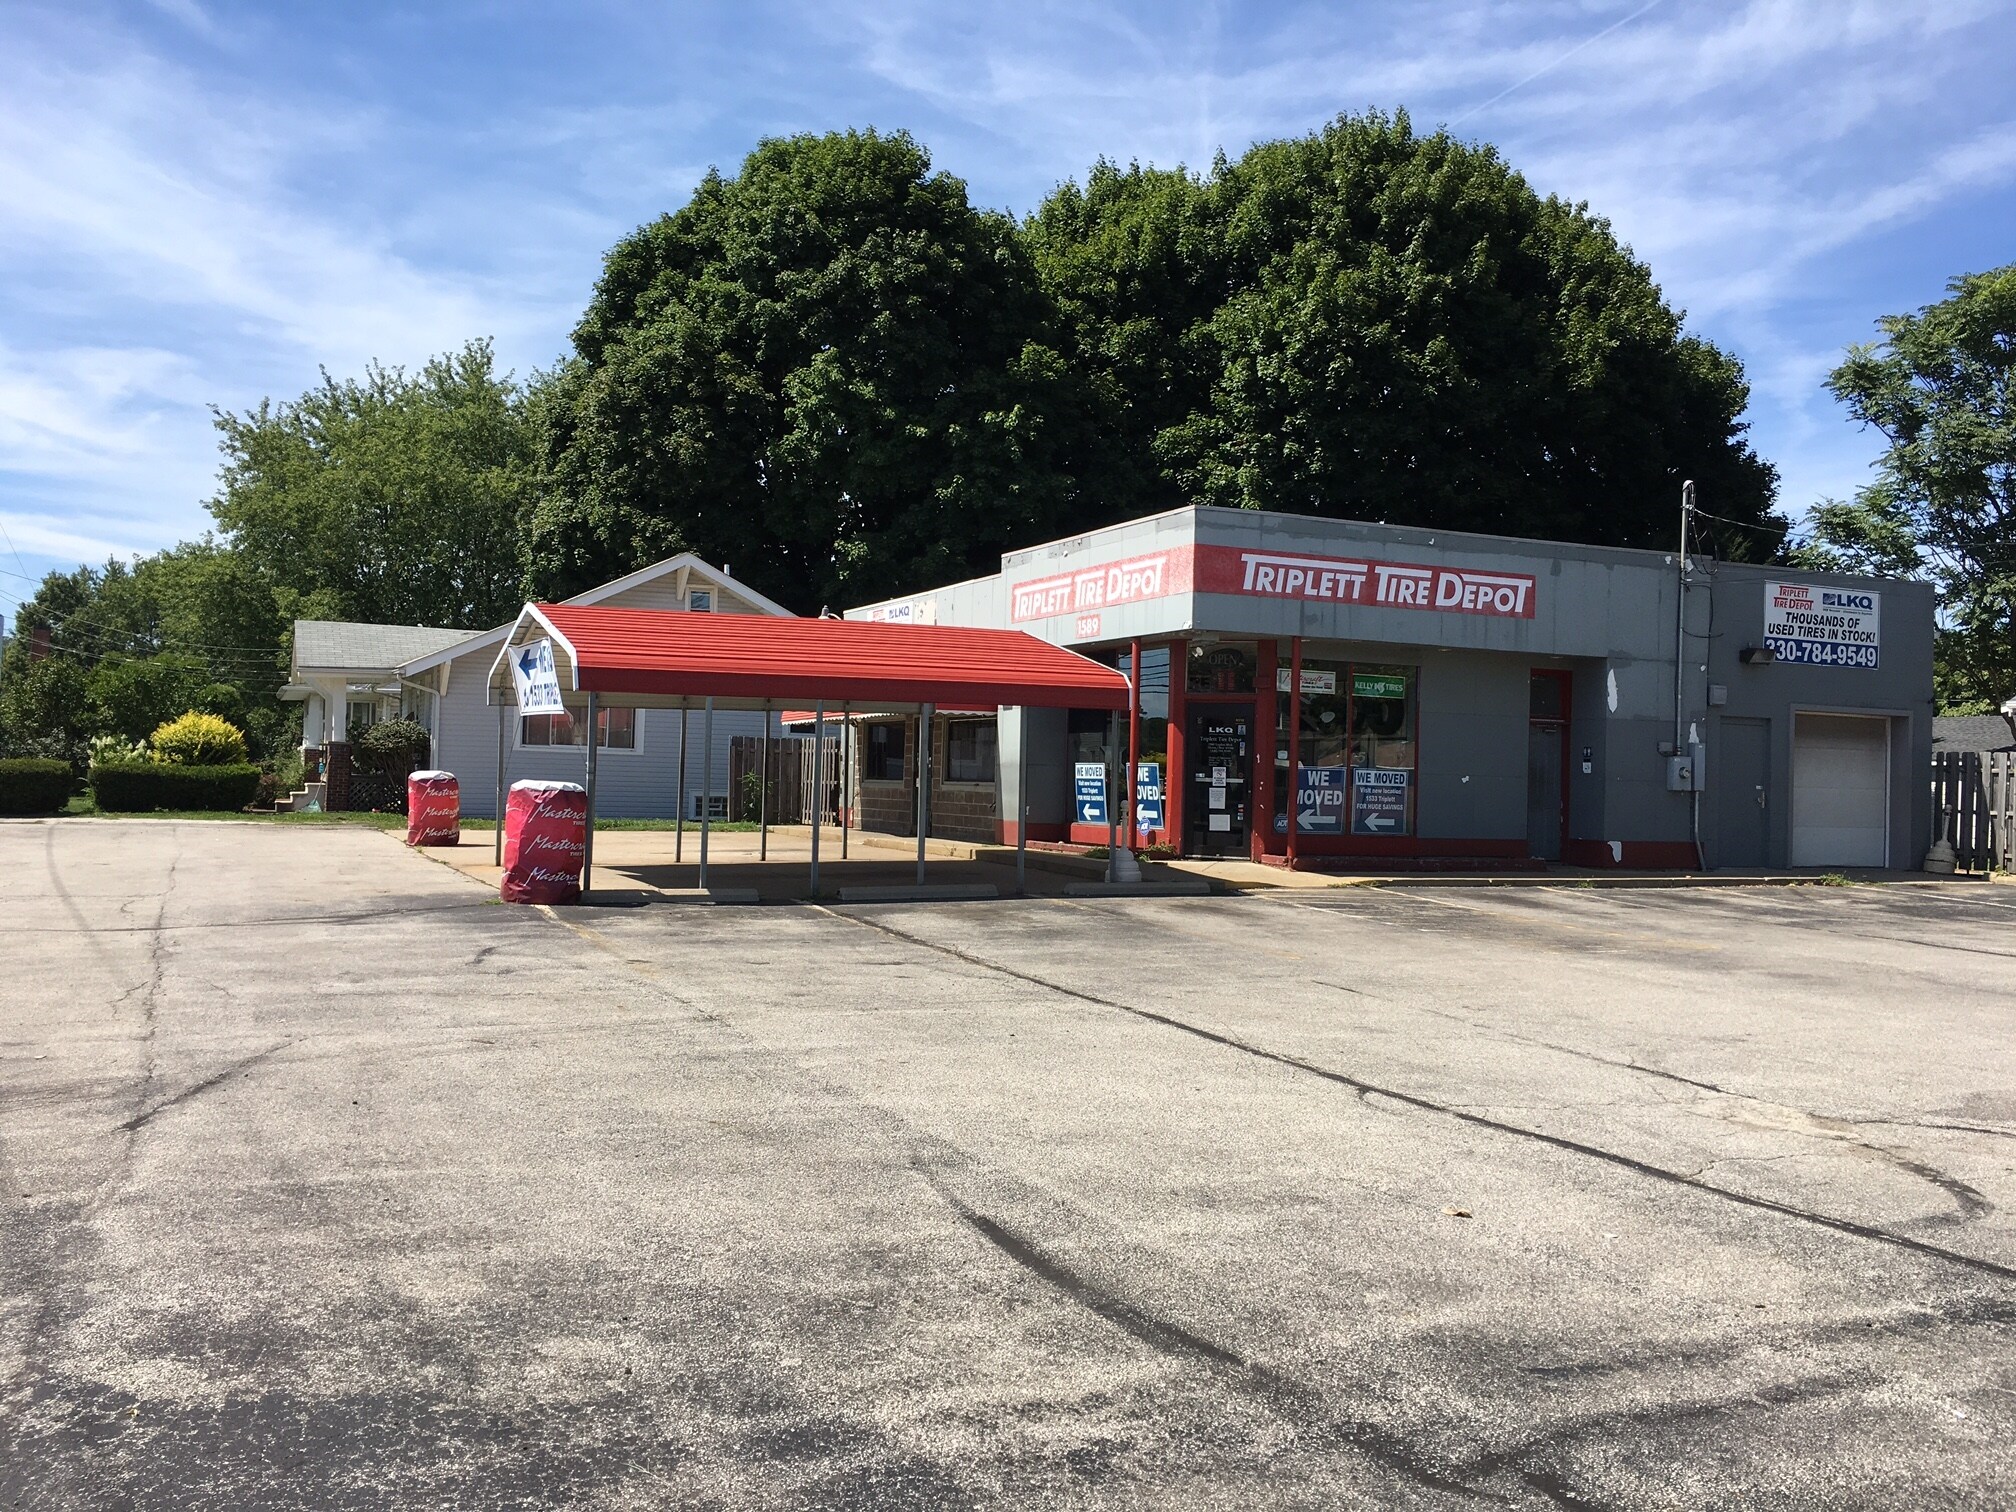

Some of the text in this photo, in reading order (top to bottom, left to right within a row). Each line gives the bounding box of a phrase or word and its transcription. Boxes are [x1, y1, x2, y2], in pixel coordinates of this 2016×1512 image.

[1014, 557, 1167, 618] TRIPLETT TIRE DEPOT
[1241, 553, 1532, 613] TRIPLETT TIRE DEPOT
[1779, 585, 1809, 598] TRIPLETT
[1774, 597, 1814, 611] TIRE DEPOT
[1837, 594, 1873, 610] LKQ
[1077, 618, 1099, 635] 1589
[1786, 612, 1860, 629] THOUSANDS OF
[1768, 623, 1875, 643] USED TIRES IN STOCK!
[1354, 681, 1374, 689] KELLY
[1386, 683, 1404, 692] TIRES
[1077, 767, 1103, 777] WE MOVED
[1307, 771, 1330, 786] WE
[1356, 772, 1405, 785] WE MOVED
[1137, 785, 1159, 801] OVED
[1360, 786, 1372, 794] Visit
[1383, 787, 1402, 795] location
